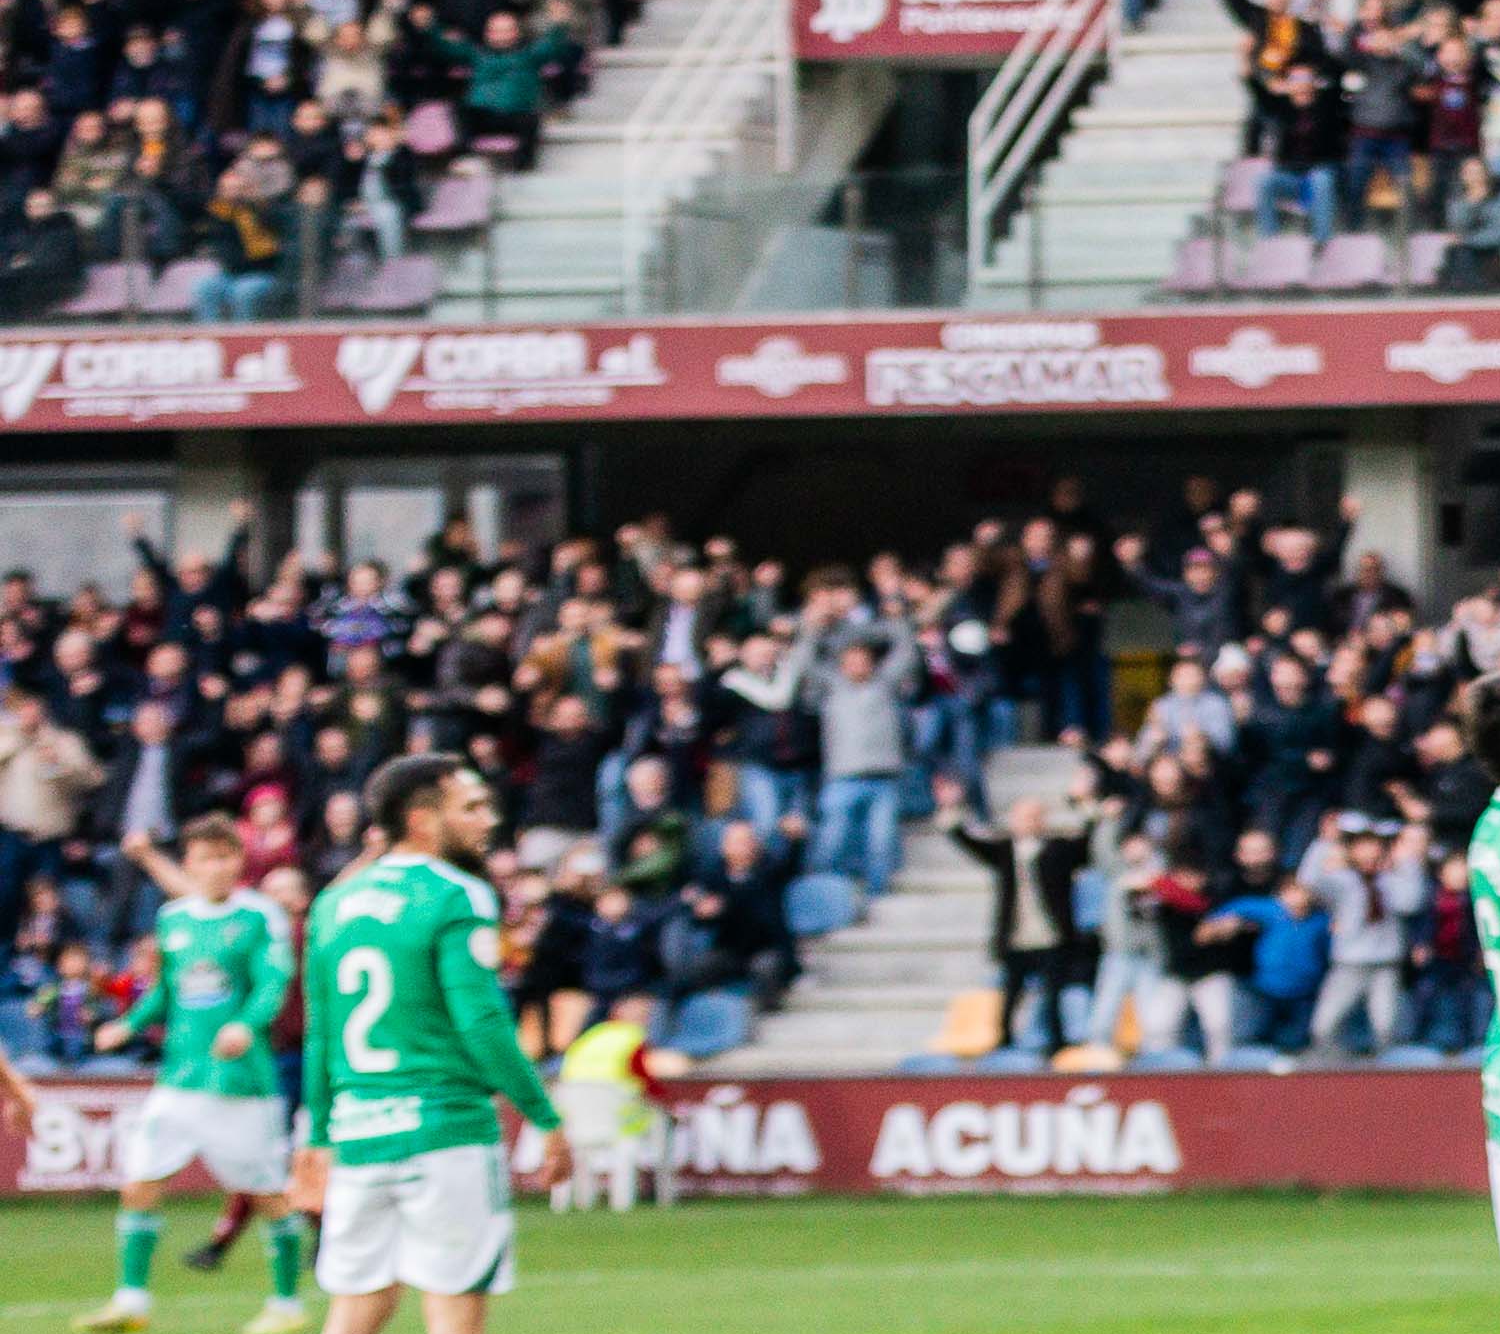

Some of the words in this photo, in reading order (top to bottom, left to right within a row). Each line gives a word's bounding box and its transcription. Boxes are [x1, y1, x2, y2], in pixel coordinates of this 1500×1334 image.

[866, 345, 1173, 406] PESCAMAR
[337, 946, 398, 1072] 2
[871, 1085, 1181, 1177] ACUÑA
